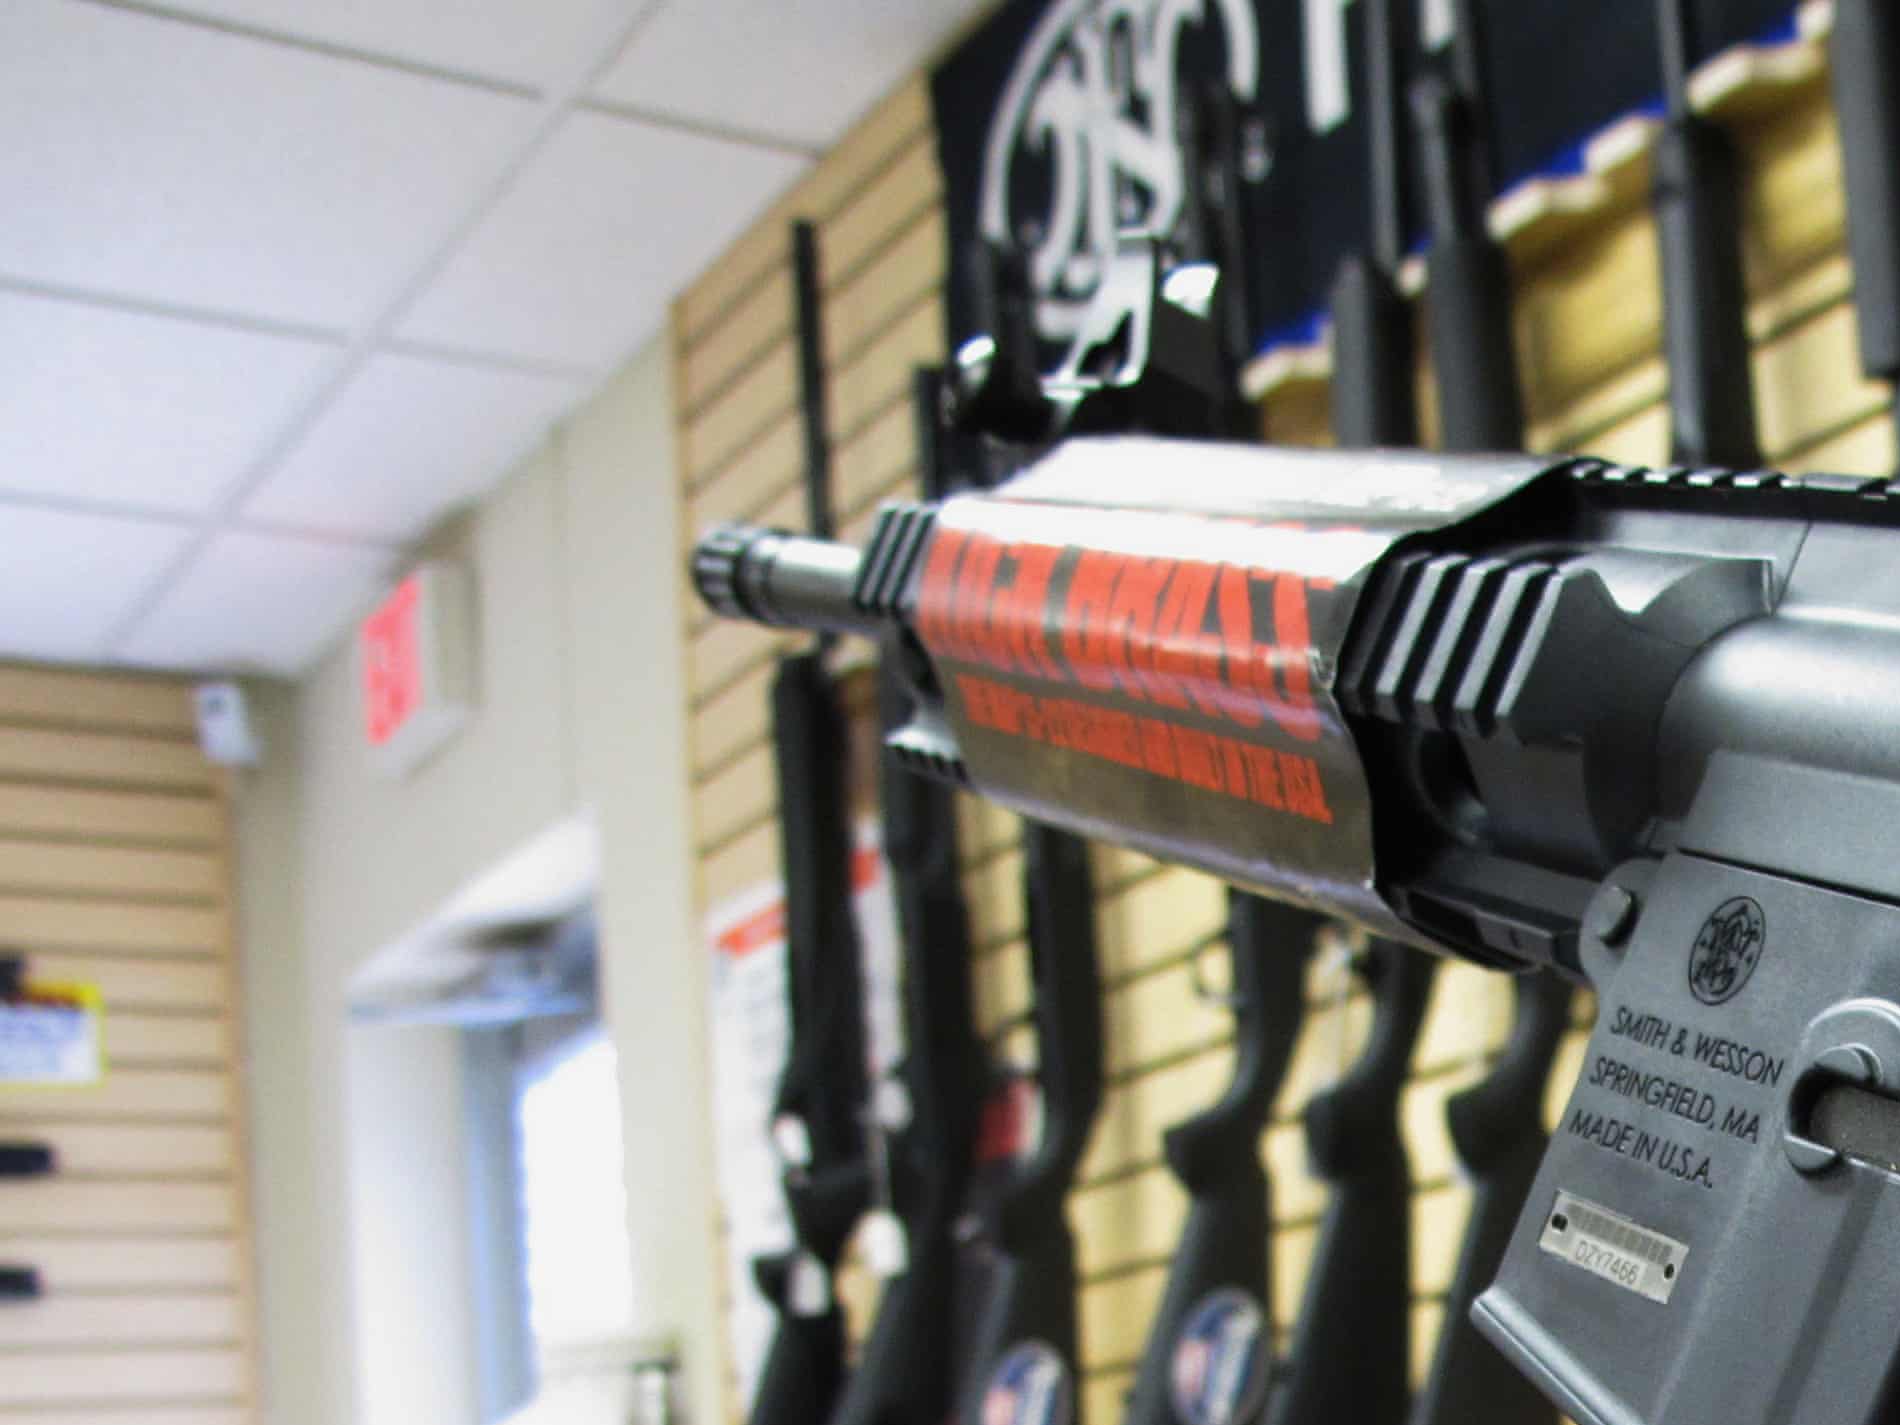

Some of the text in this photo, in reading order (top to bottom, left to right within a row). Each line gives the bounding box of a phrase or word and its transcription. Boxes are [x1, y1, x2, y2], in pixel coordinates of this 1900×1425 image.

[1611, 1006, 1785, 1085] SMITH & WESSON
[1590, 1056, 1761, 1144] SPRINGFIELD, MA
[1569, 1110, 1713, 1188] MADE IN U.S.A.
